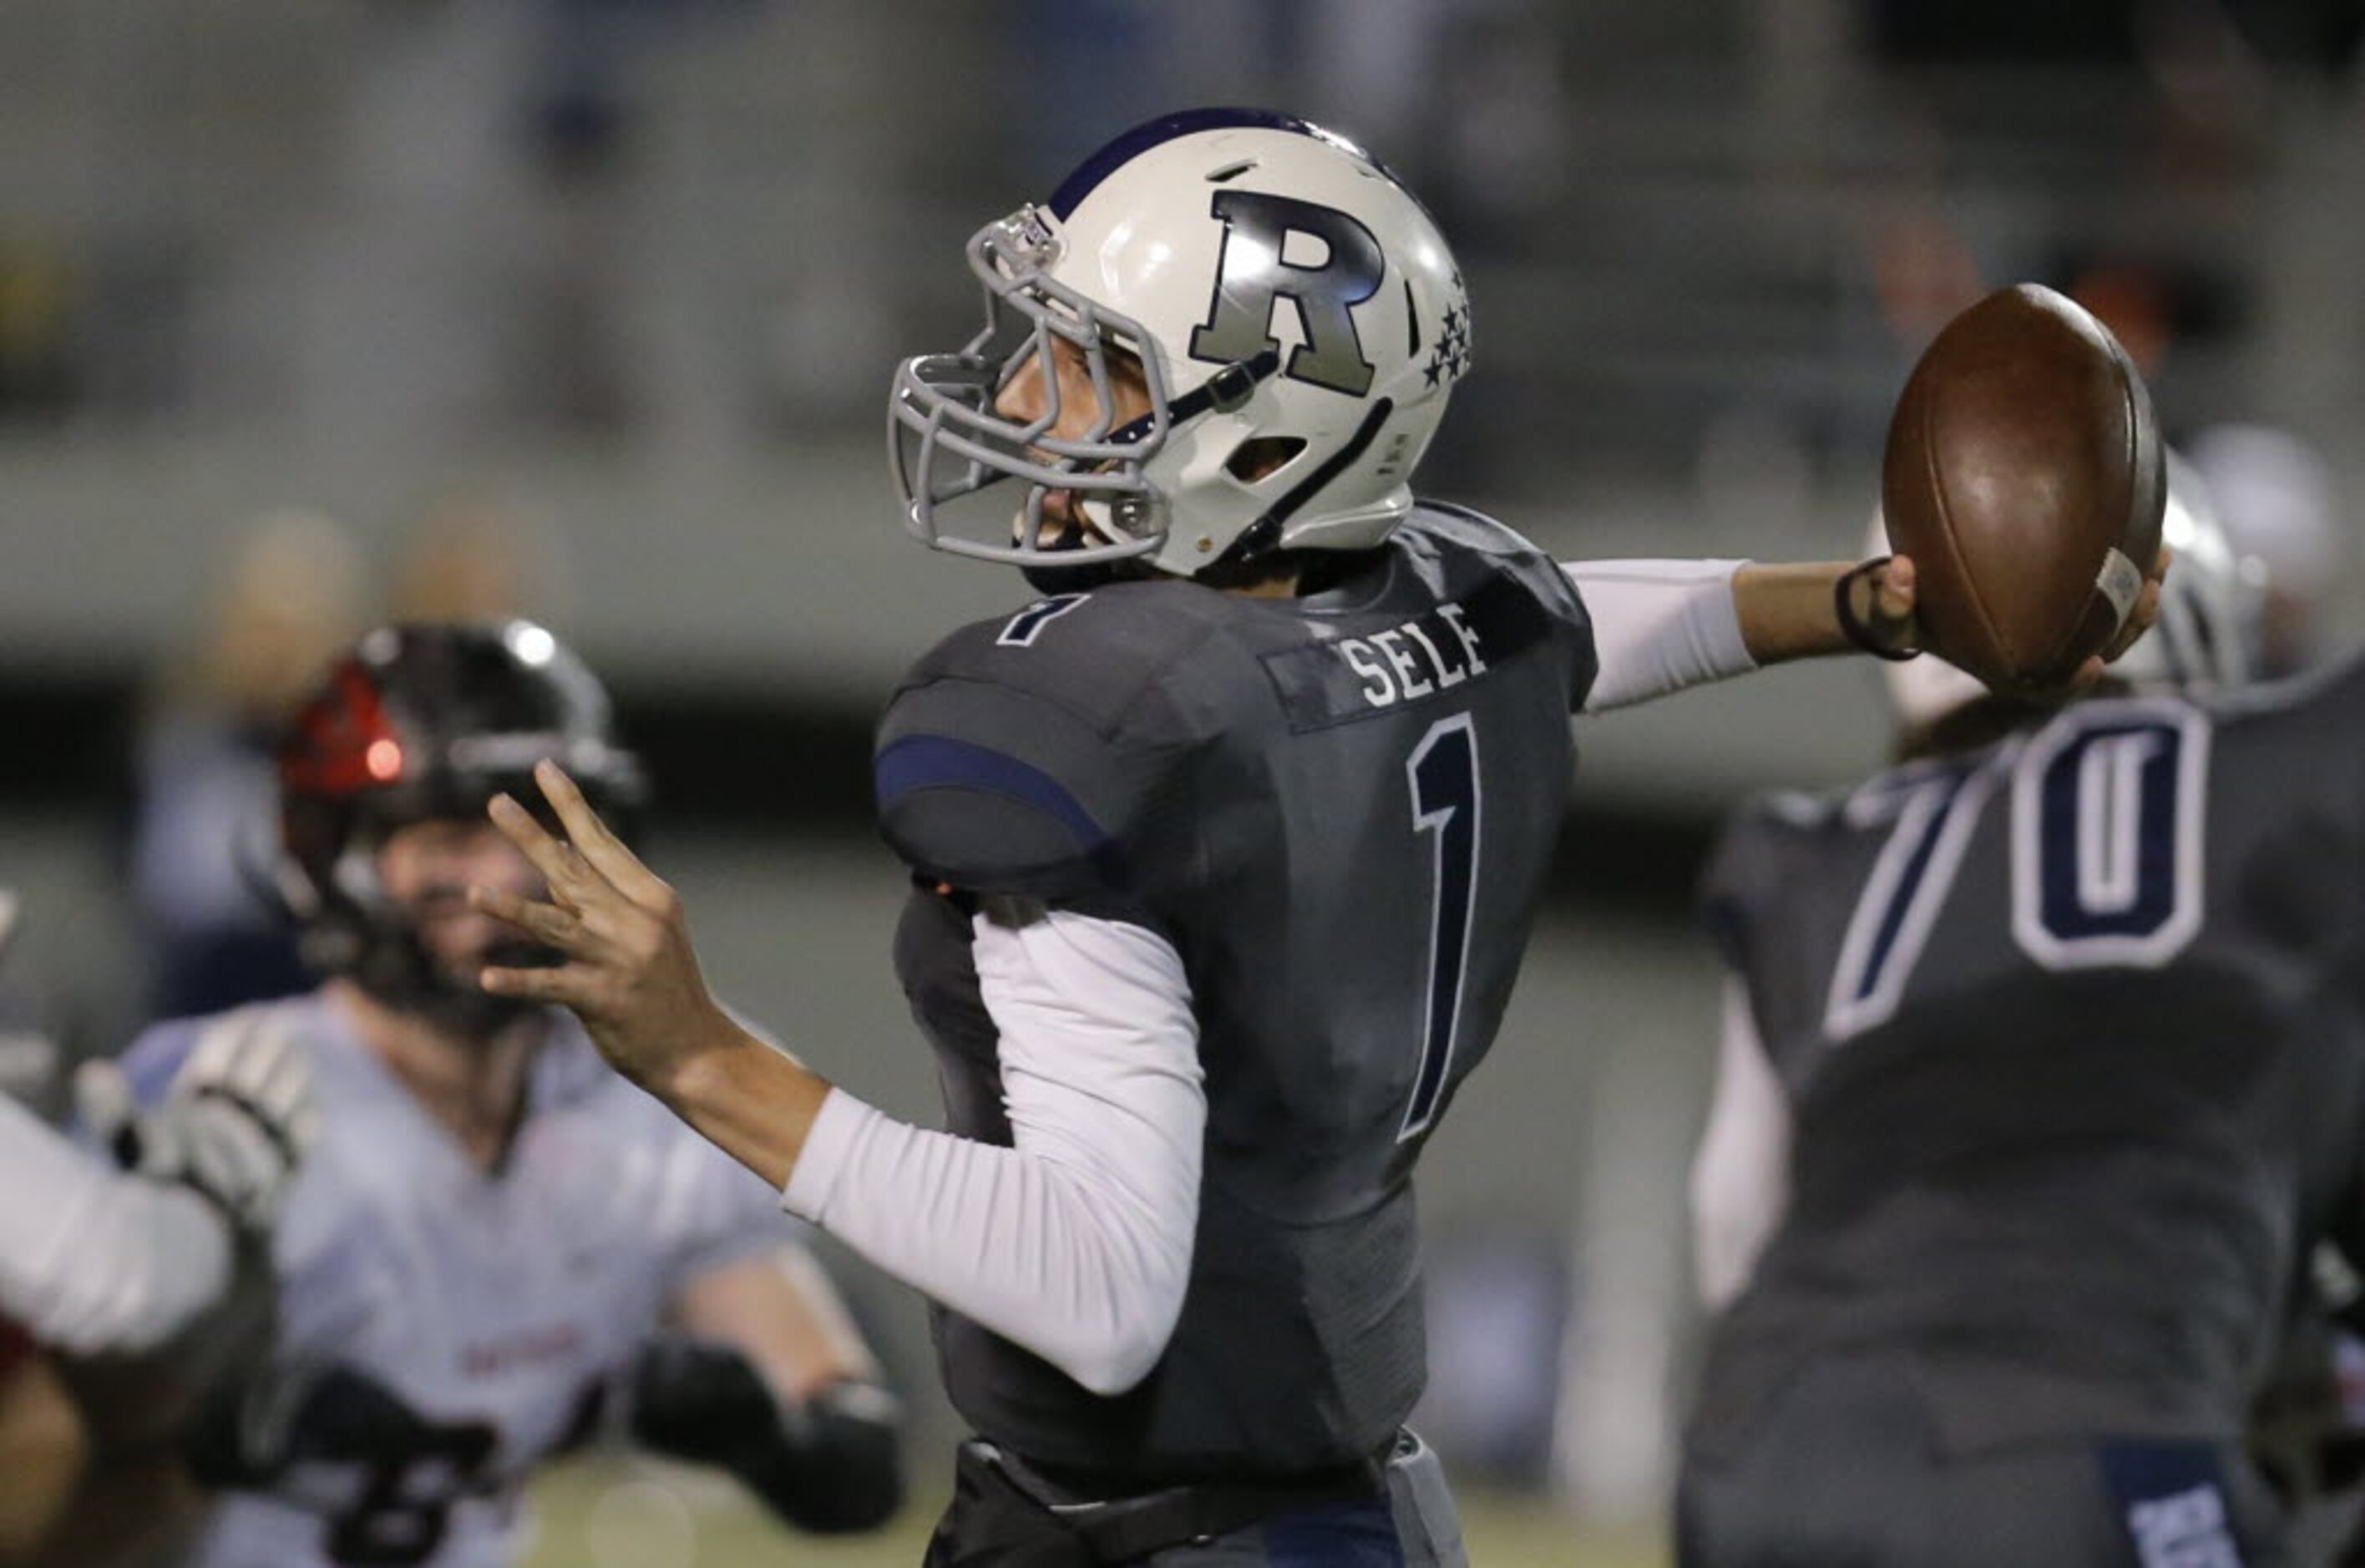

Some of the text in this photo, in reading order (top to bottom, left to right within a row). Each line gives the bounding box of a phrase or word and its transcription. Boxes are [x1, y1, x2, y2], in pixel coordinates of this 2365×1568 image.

[1188, 190, 1386, 399] R
[1339, 602, 1487, 708] SELF
[1396, 711, 1481, 1144] 1
[1822, 699, 2211, 1044] 70
